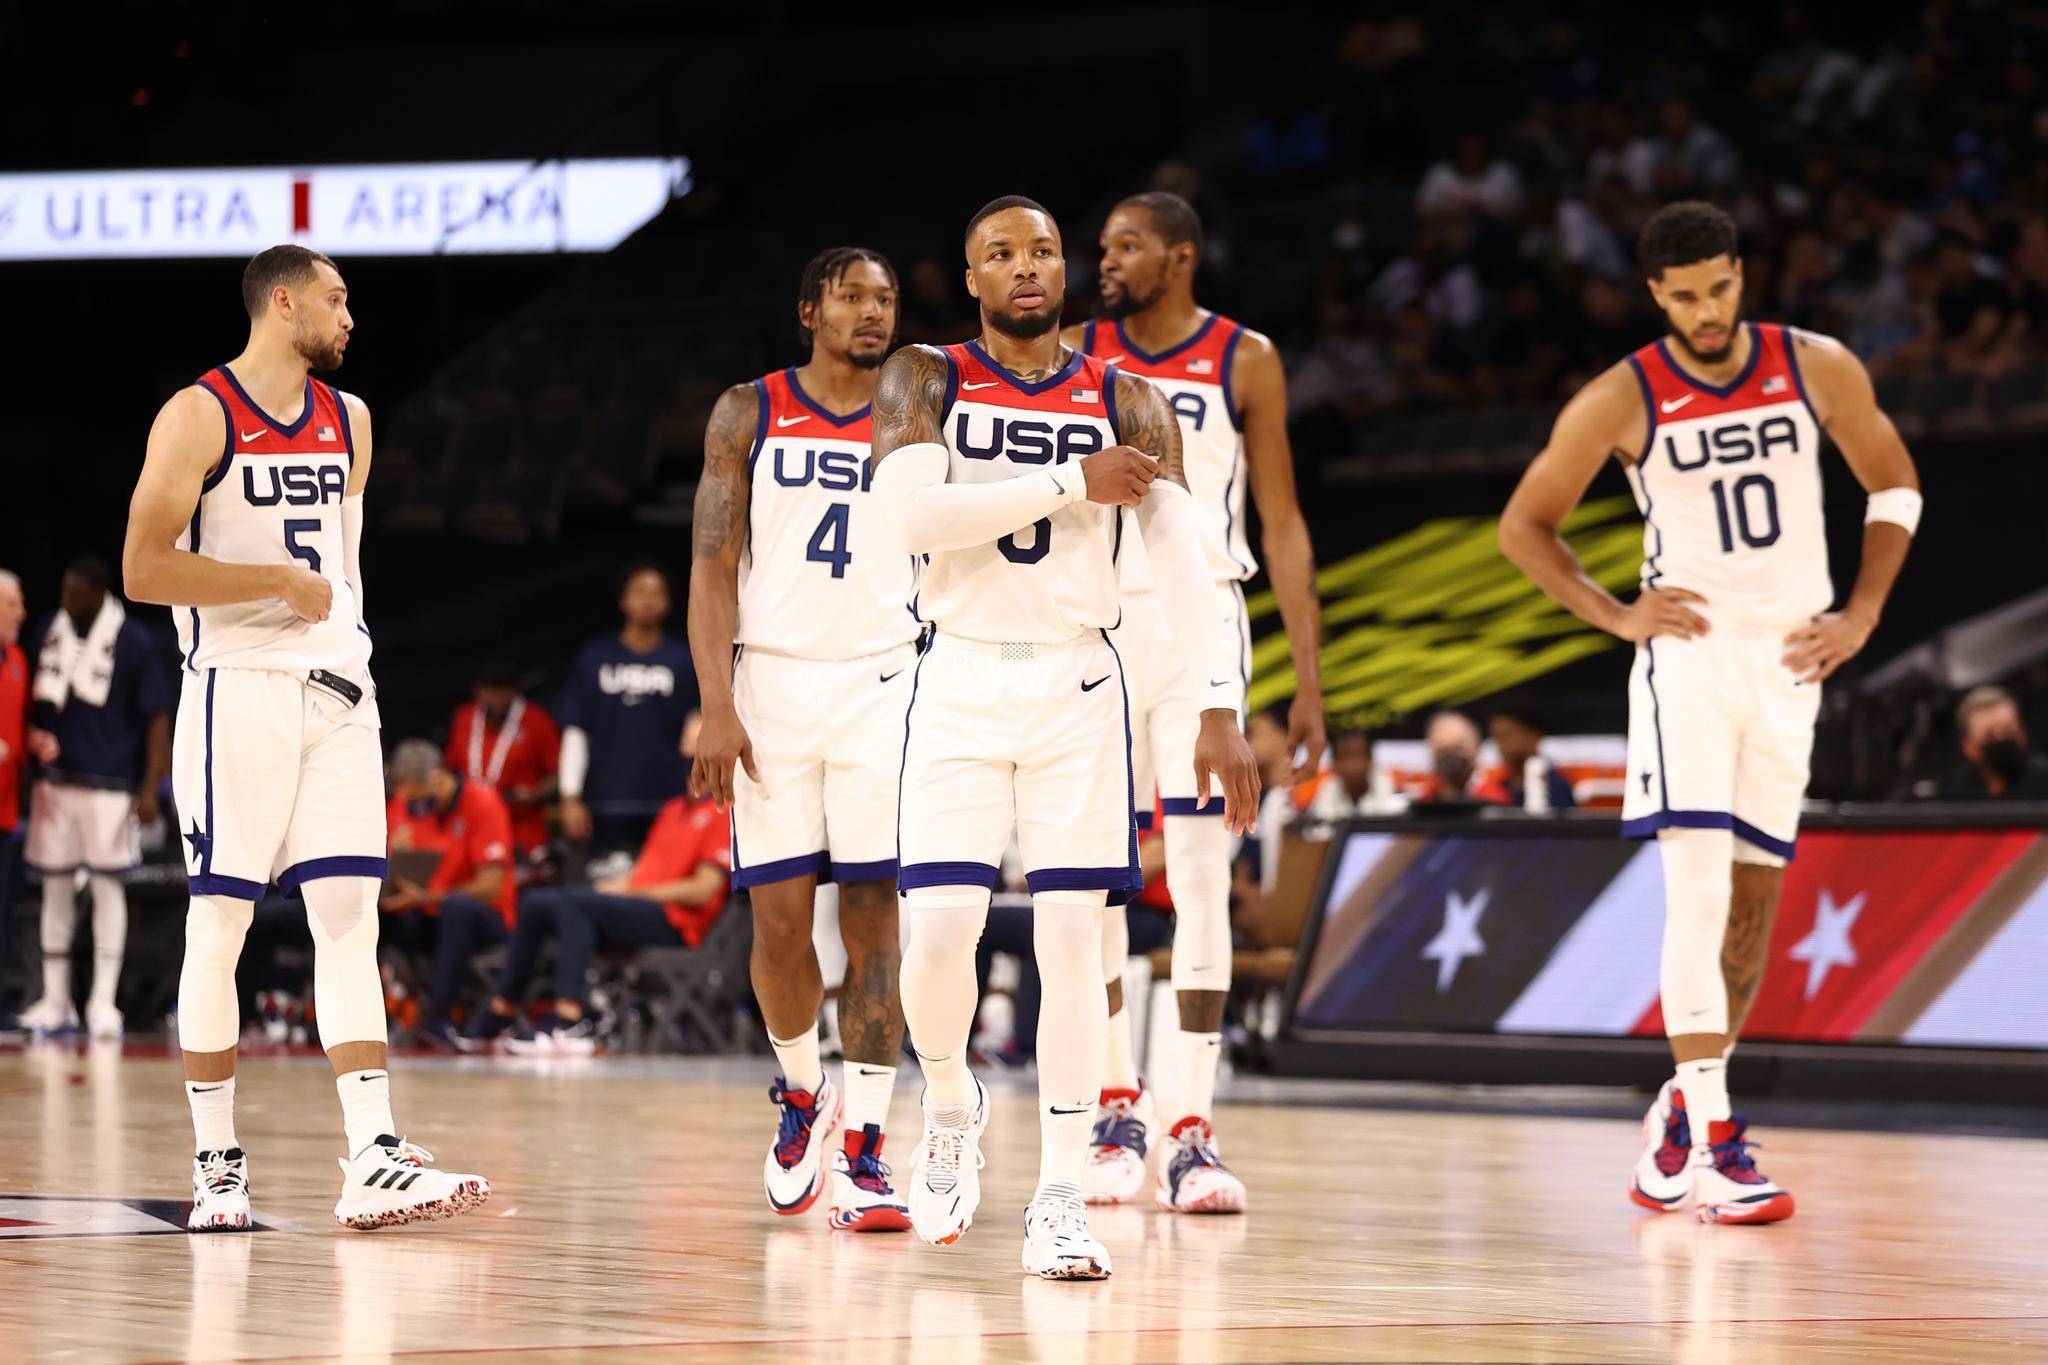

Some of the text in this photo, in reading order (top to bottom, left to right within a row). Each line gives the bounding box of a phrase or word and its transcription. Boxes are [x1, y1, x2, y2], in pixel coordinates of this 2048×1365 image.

[45, 187, 258, 240] ULTRA
[956, 413, 1103, 465] USA
[1665, 416, 1799, 472] USA
[243, 465, 345, 507] USA
[1710, 474, 1781, 553] 10
[284, 519, 321, 574] 5
[806, 503, 852, 579] 4
